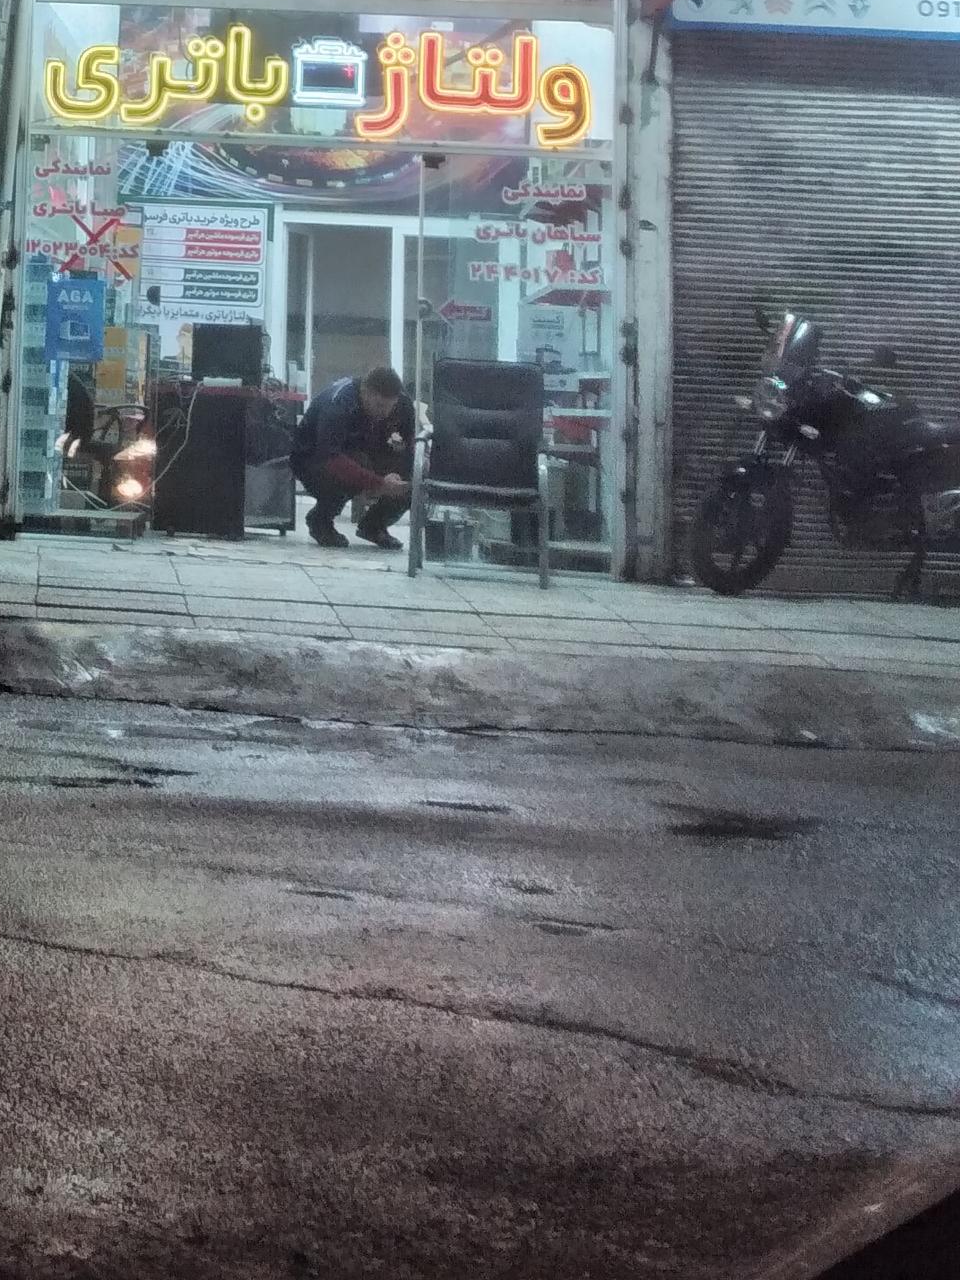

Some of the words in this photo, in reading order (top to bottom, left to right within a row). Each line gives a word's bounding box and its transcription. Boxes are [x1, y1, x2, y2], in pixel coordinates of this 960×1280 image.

[44, 24, 290, 125] باتری
[355, 28, 594, 148] ولتاژ
[32, 201, 87, 219] باتری
[168, 211, 194, 226] باتری
[195, 213, 218, 227] خرید
[219, 213, 239, 228] ویژه
[239, 215, 260, 229] طرح
[474, 220, 528, 244] باتری
